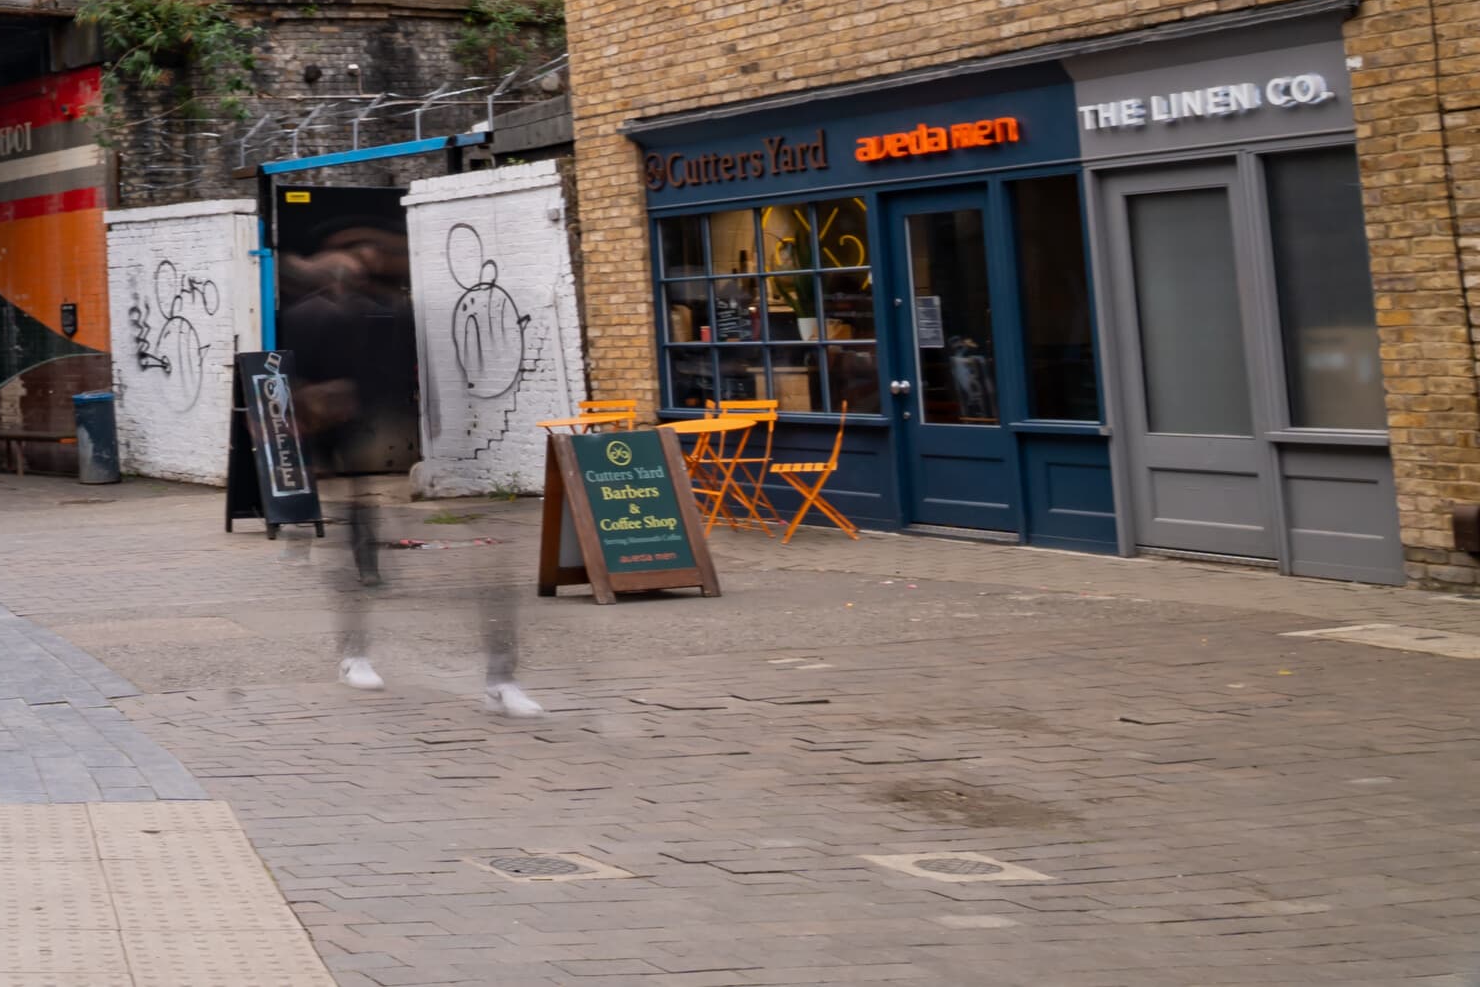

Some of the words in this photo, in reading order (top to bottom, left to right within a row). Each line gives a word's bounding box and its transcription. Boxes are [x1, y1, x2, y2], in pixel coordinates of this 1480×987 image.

[1078, 98, 1146, 130] THE
[1151, 82, 1261, 122] LINEN
[855, 123, 948, 163] aveda
[949, 117, 1019, 150] men
[667, 150, 765, 190] Cutters
[761, 127, 829, 177] Yard
[585, 469, 634, 483] Cutters
[633, 465, 665, 480] Yard
[600, 484, 660, 501] Barbers
[628, 503, 642, 515] &
[600, 517, 642, 531] Coffee
[643, 515, 678, 531] Shop
